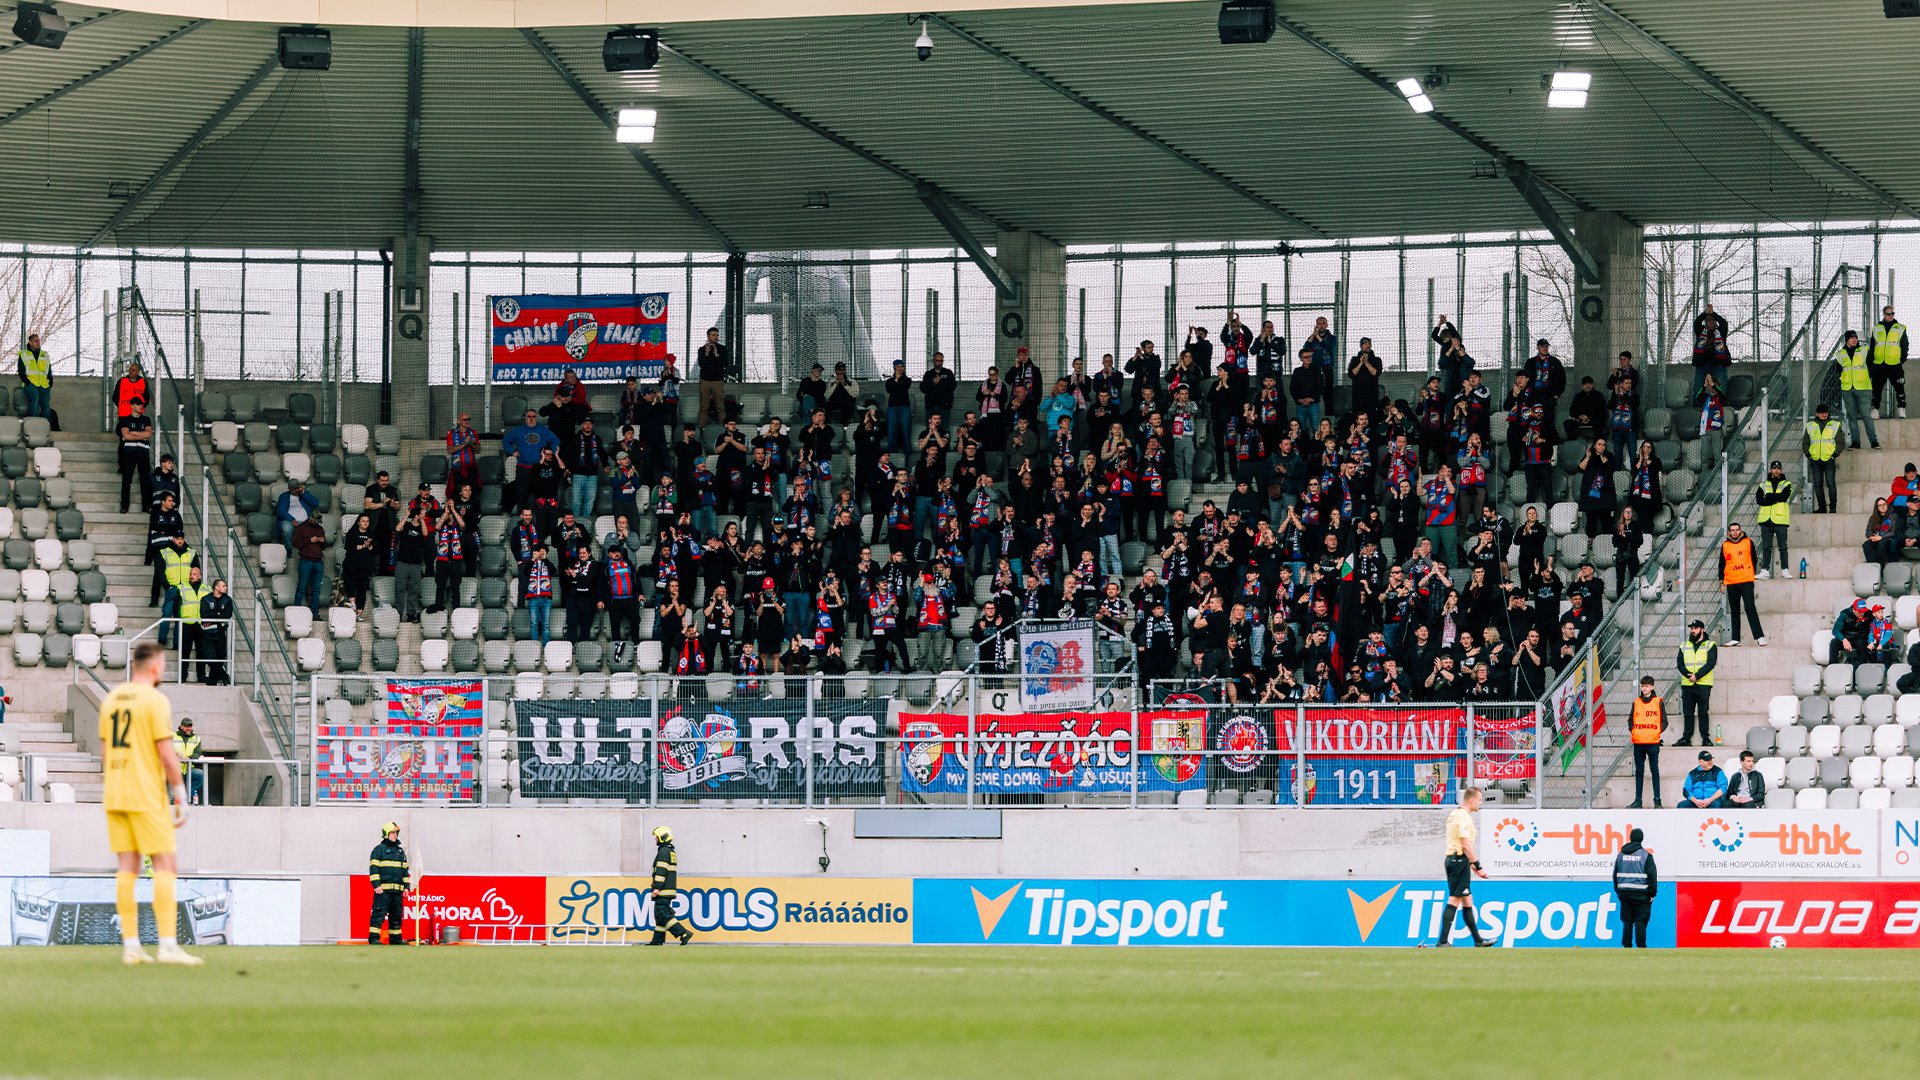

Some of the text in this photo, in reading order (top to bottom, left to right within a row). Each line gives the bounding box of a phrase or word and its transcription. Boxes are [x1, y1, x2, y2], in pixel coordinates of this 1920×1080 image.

[1580, 296, 1603, 323] Q
[399, 314, 423, 341] Q
[1001, 312, 1024, 339] Q
[110, 709, 132, 749] 12
[1285, 714, 1450, 752] VIKTORIÁNI
[521, 757, 650, 792] Supporters
[686, 761, 721, 784] 1911
[947, 771, 965, 786] MY
[1004, 771, 1041, 786] DOMA
[1334, 769, 1396, 800] 1911
[330, 783, 381, 792] VIKTORIA
[419, 783, 461, 792] HRDOST
[1749, 824, 1862, 855] thhk
[434, 907, 484, 920] HORA
[785, 901, 908, 923] Ráááádio
[1025, 888, 1228, 944] Tipsport
[1404, 891, 1617, 947] Tipsport
